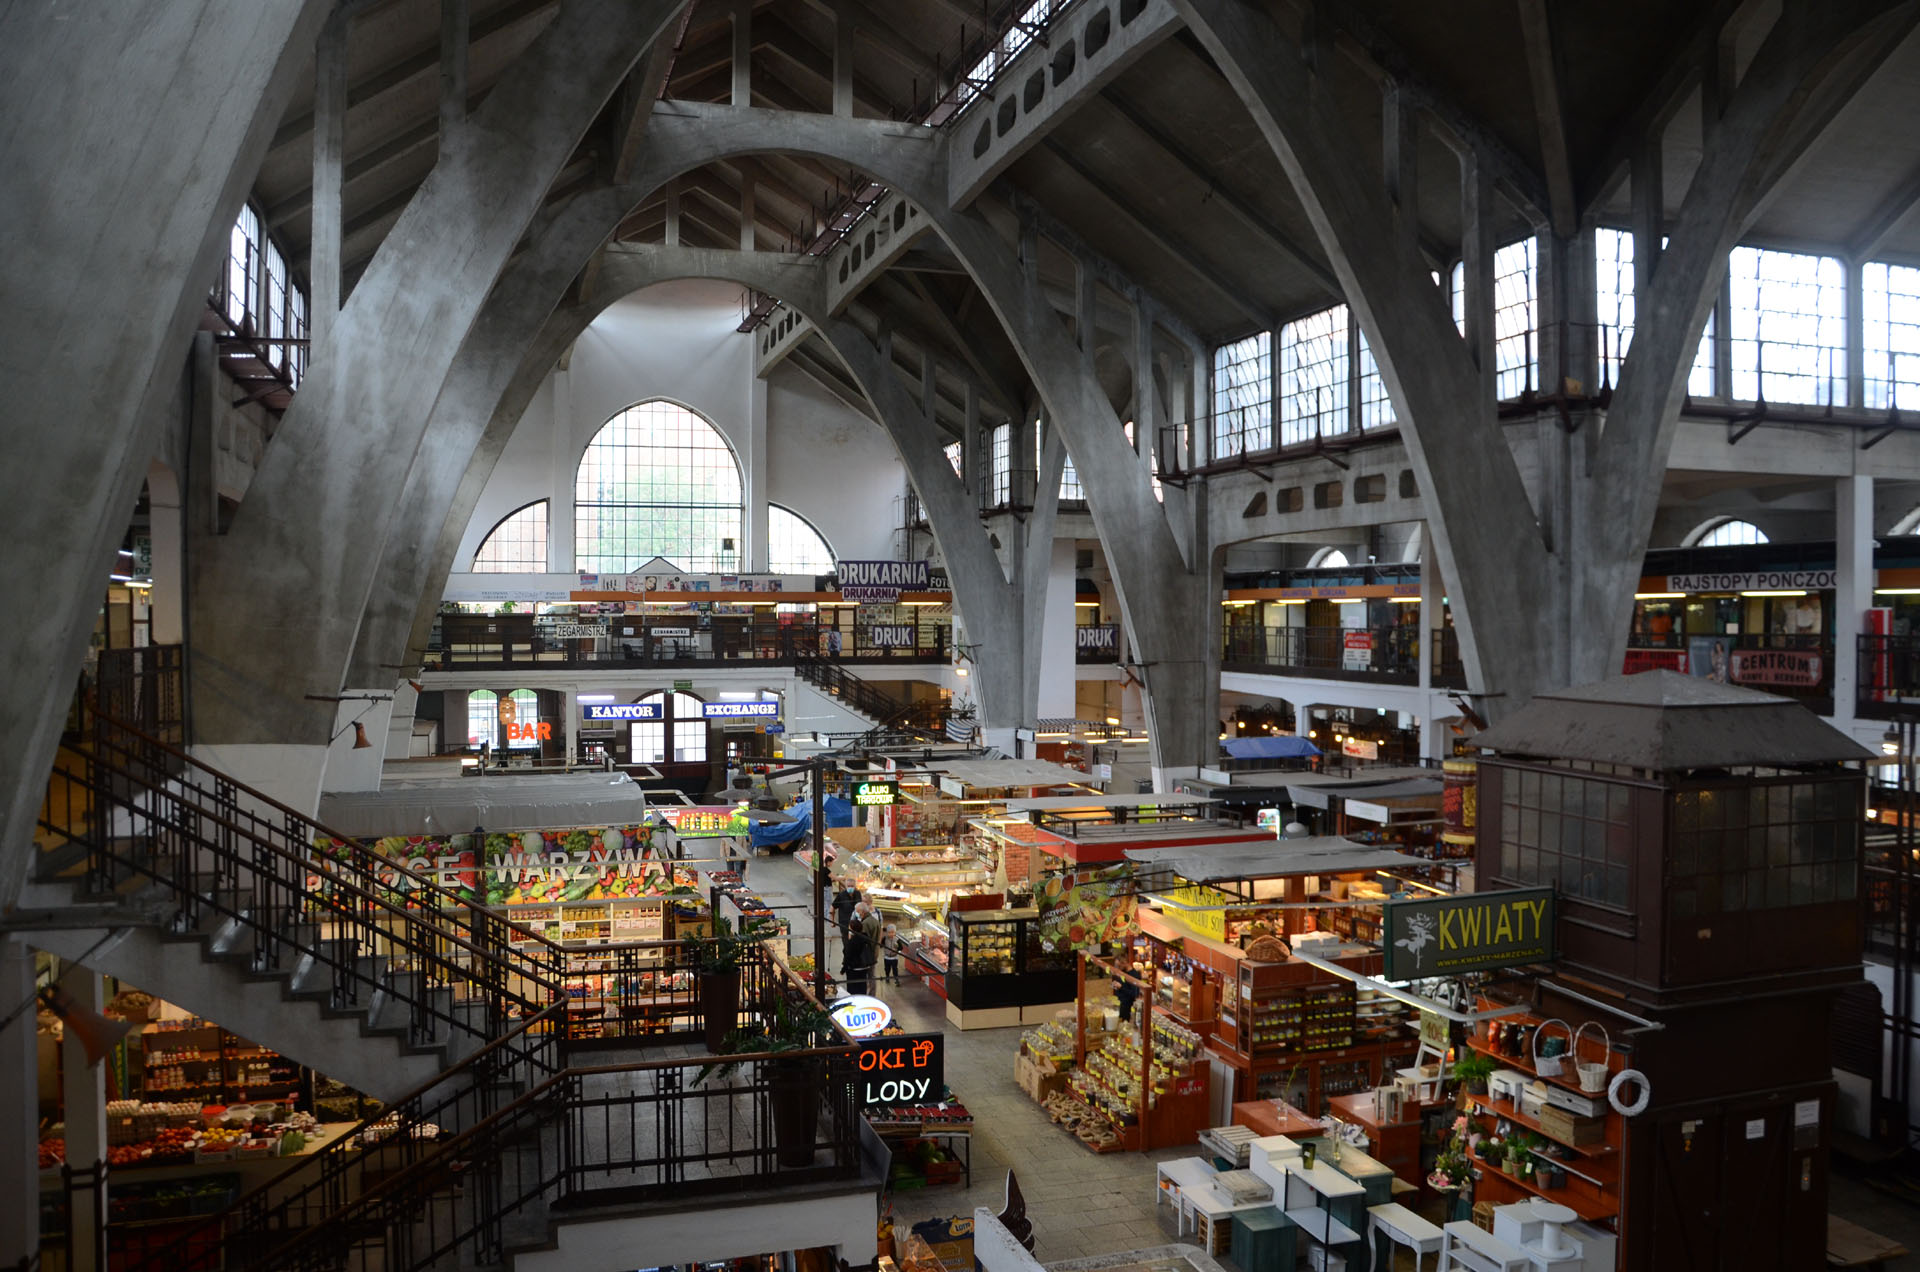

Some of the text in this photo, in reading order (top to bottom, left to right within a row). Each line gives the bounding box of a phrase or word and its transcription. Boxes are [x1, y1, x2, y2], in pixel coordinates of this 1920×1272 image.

[838, 562, 927, 585] DRUKARNIA
[1672, 573, 1752, 590] RAJSTOPY
[843, 587, 897, 599] DRUKARNIA
[558, 625, 605, 637] ZEGARMISTRZ
[874, 626, 911, 645] DRUK
[1077, 627, 1113, 648] DRUK
[1741, 653, 1809, 673] CENTRUM
[591, 705, 654, 718] KANTOR
[706, 703, 777, 716] EXCHANGE
[507, 722, 552, 740] BAR
[494, 848, 666, 883] WARZYWA
[1439, 898, 1548, 951] KWIATY
[846, 1012, 877, 1027] LOTTO
[845, 1048, 906, 1072] OKI
[866, 1077, 931, 1104] LODY
